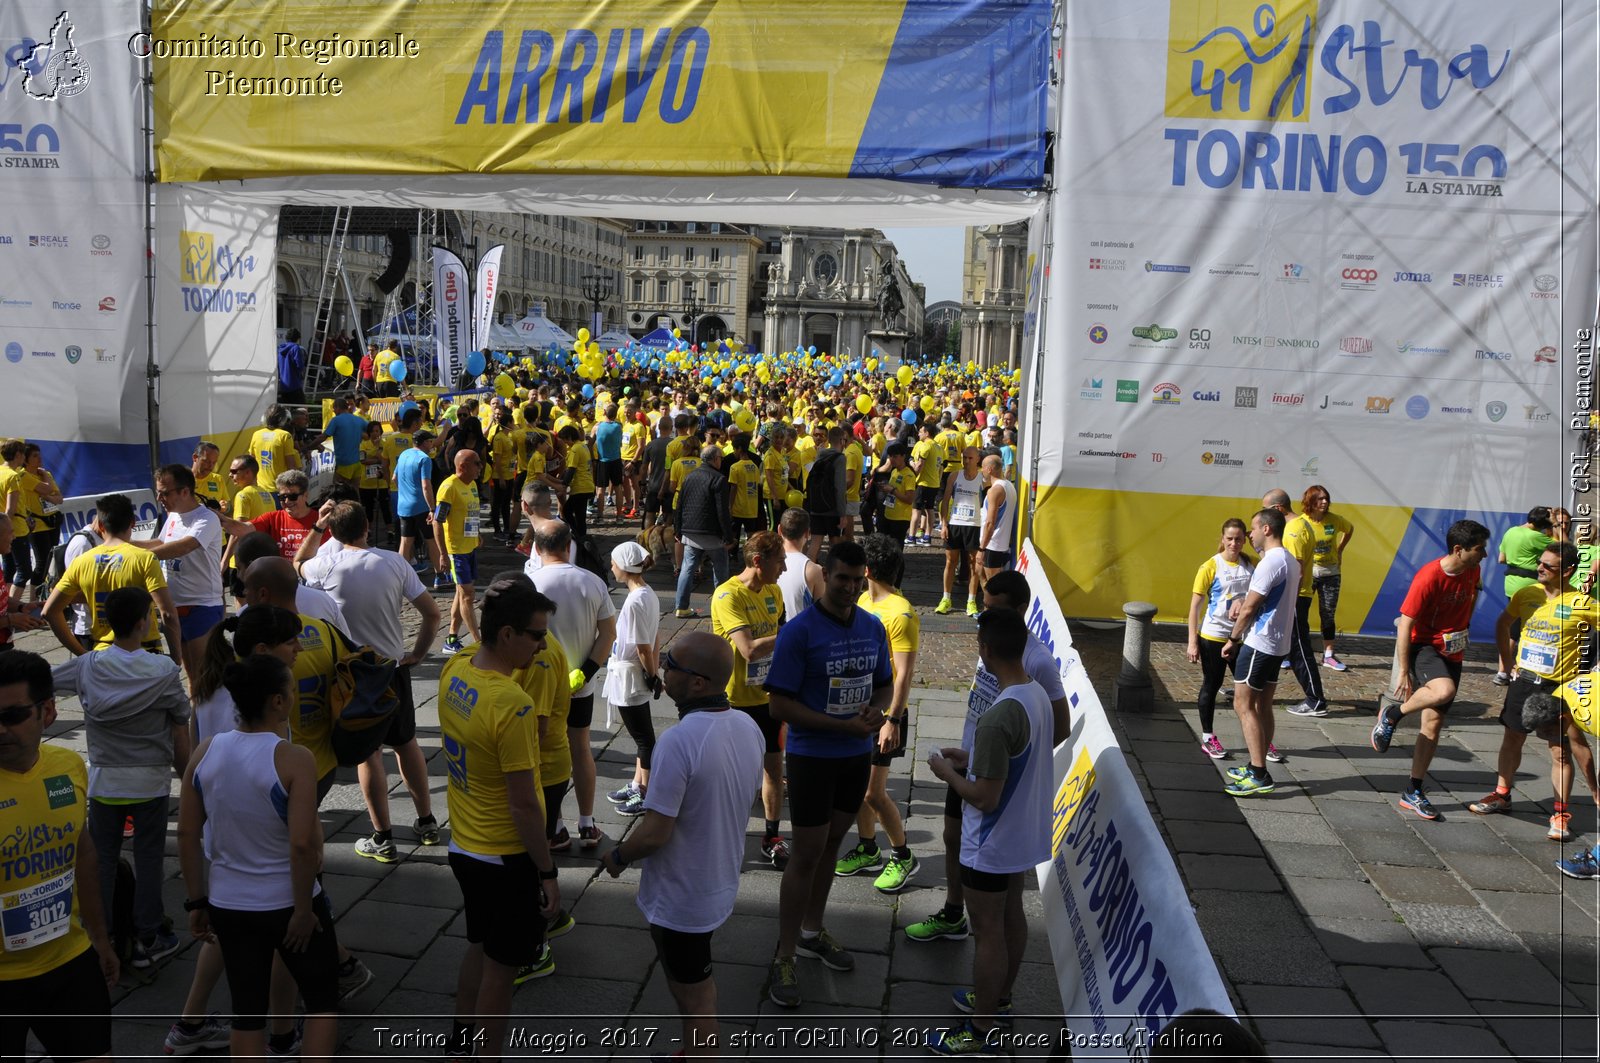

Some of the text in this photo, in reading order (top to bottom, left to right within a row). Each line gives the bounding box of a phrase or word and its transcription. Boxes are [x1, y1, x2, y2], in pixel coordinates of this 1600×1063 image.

[455, 26, 710, 125] ARRIVO
[1320, 20, 1511, 116] Stra
[0, 123, 60, 152] 50
[4, 157, 60, 168] STAMPA
[1164, 128, 1388, 196] TORINO
[1399, 142, 1508, 179] 150
[1405, 181, 1504, 197] LA STAMPA
[40, 235, 68, 243] REALE
[1342, 268, 1378, 283] coop
[1468, 274, 1504, 283] REALE
[181, 287, 233, 313] TORINO
[1190, 329, 1211, 342] GO
[1232, 336, 1262, 346] INTESA
[1192, 390, 1221, 402] Cuki
[1272, 392, 1305, 405] inalpi
[1441, 406, 1472, 414] mentos
[1213, 459, 1244, 467] MARATHON
[1526, 628, 1560, 643] TORINO
[448, 676, 479, 707] 150
[48, 784, 74, 799] Arredo3
[2, 843, 76, 882] TORINO
[29, 900, 67, 931] 3012
